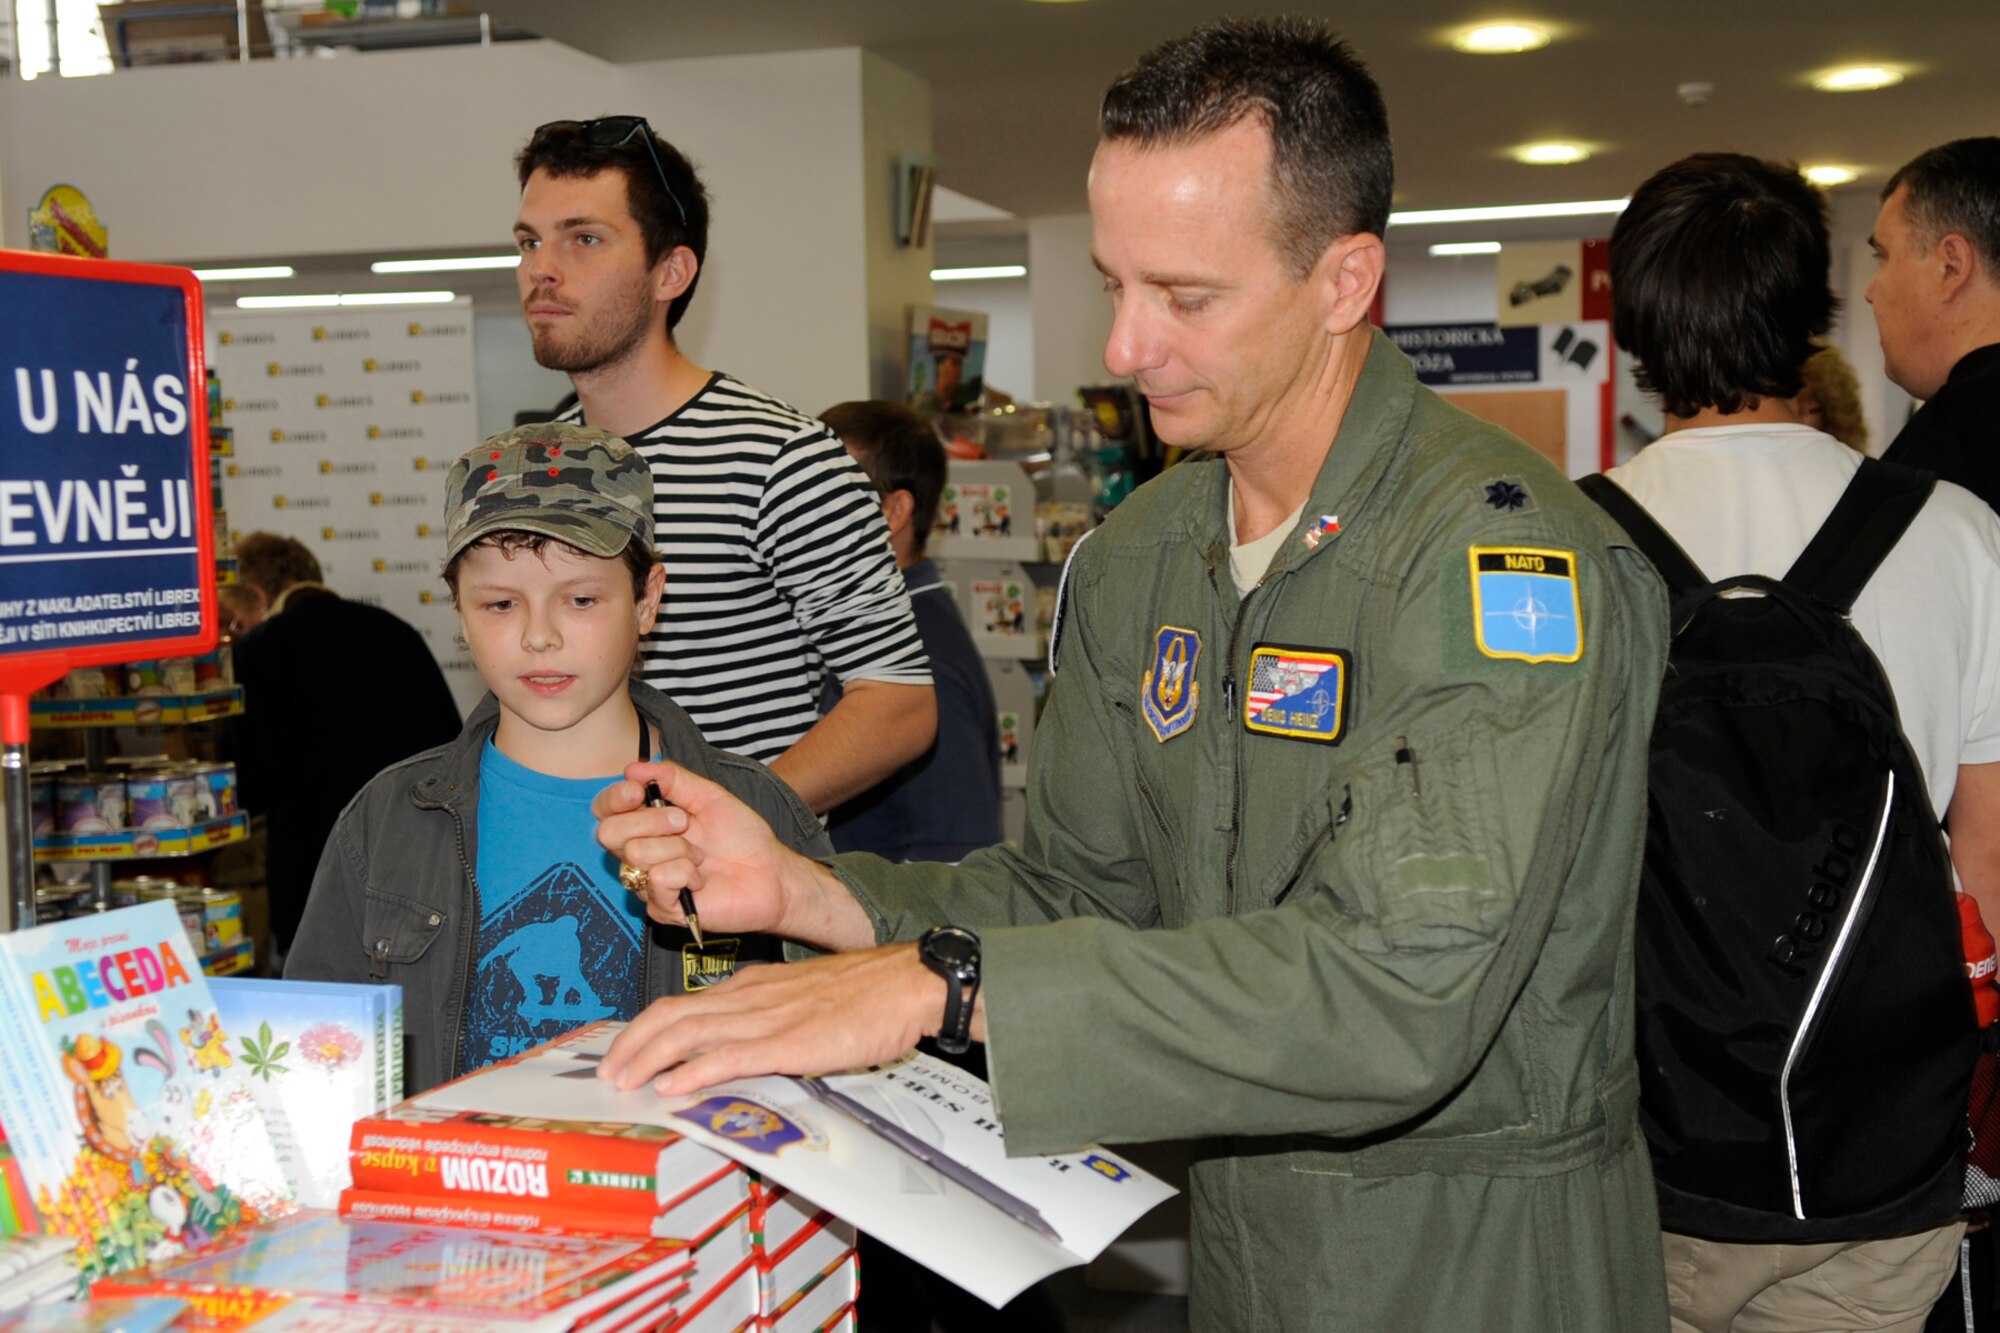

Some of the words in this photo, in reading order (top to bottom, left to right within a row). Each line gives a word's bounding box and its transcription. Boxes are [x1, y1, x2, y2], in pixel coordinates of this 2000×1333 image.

[16, 368, 58, 434] U
[75, 358, 188, 435] NÁS
[0, 465, 192, 547] EVNĚJI
[1504, 554, 1545, 572] NATO
[25, 599, 37, 617] Z
[38, 587, 153, 614] NAKLADATELSTVÍ
[155, 588, 200, 606] LIBREX
[18, 625, 30, 642] V
[31, 619, 58, 642] SÍTI
[59, 612, 153, 638] KNIHKUPECTVÍ
[155, 611, 200, 630] LIBREX
[31, 941, 192, 1024] ABECEDA
[424, 1137, 500, 1157] encyklopedie
[424, 1156, 438, 1173] v
[440, 1155, 550, 1198] ROZUM
[588, 1169, 648, 1191] LIBREX
